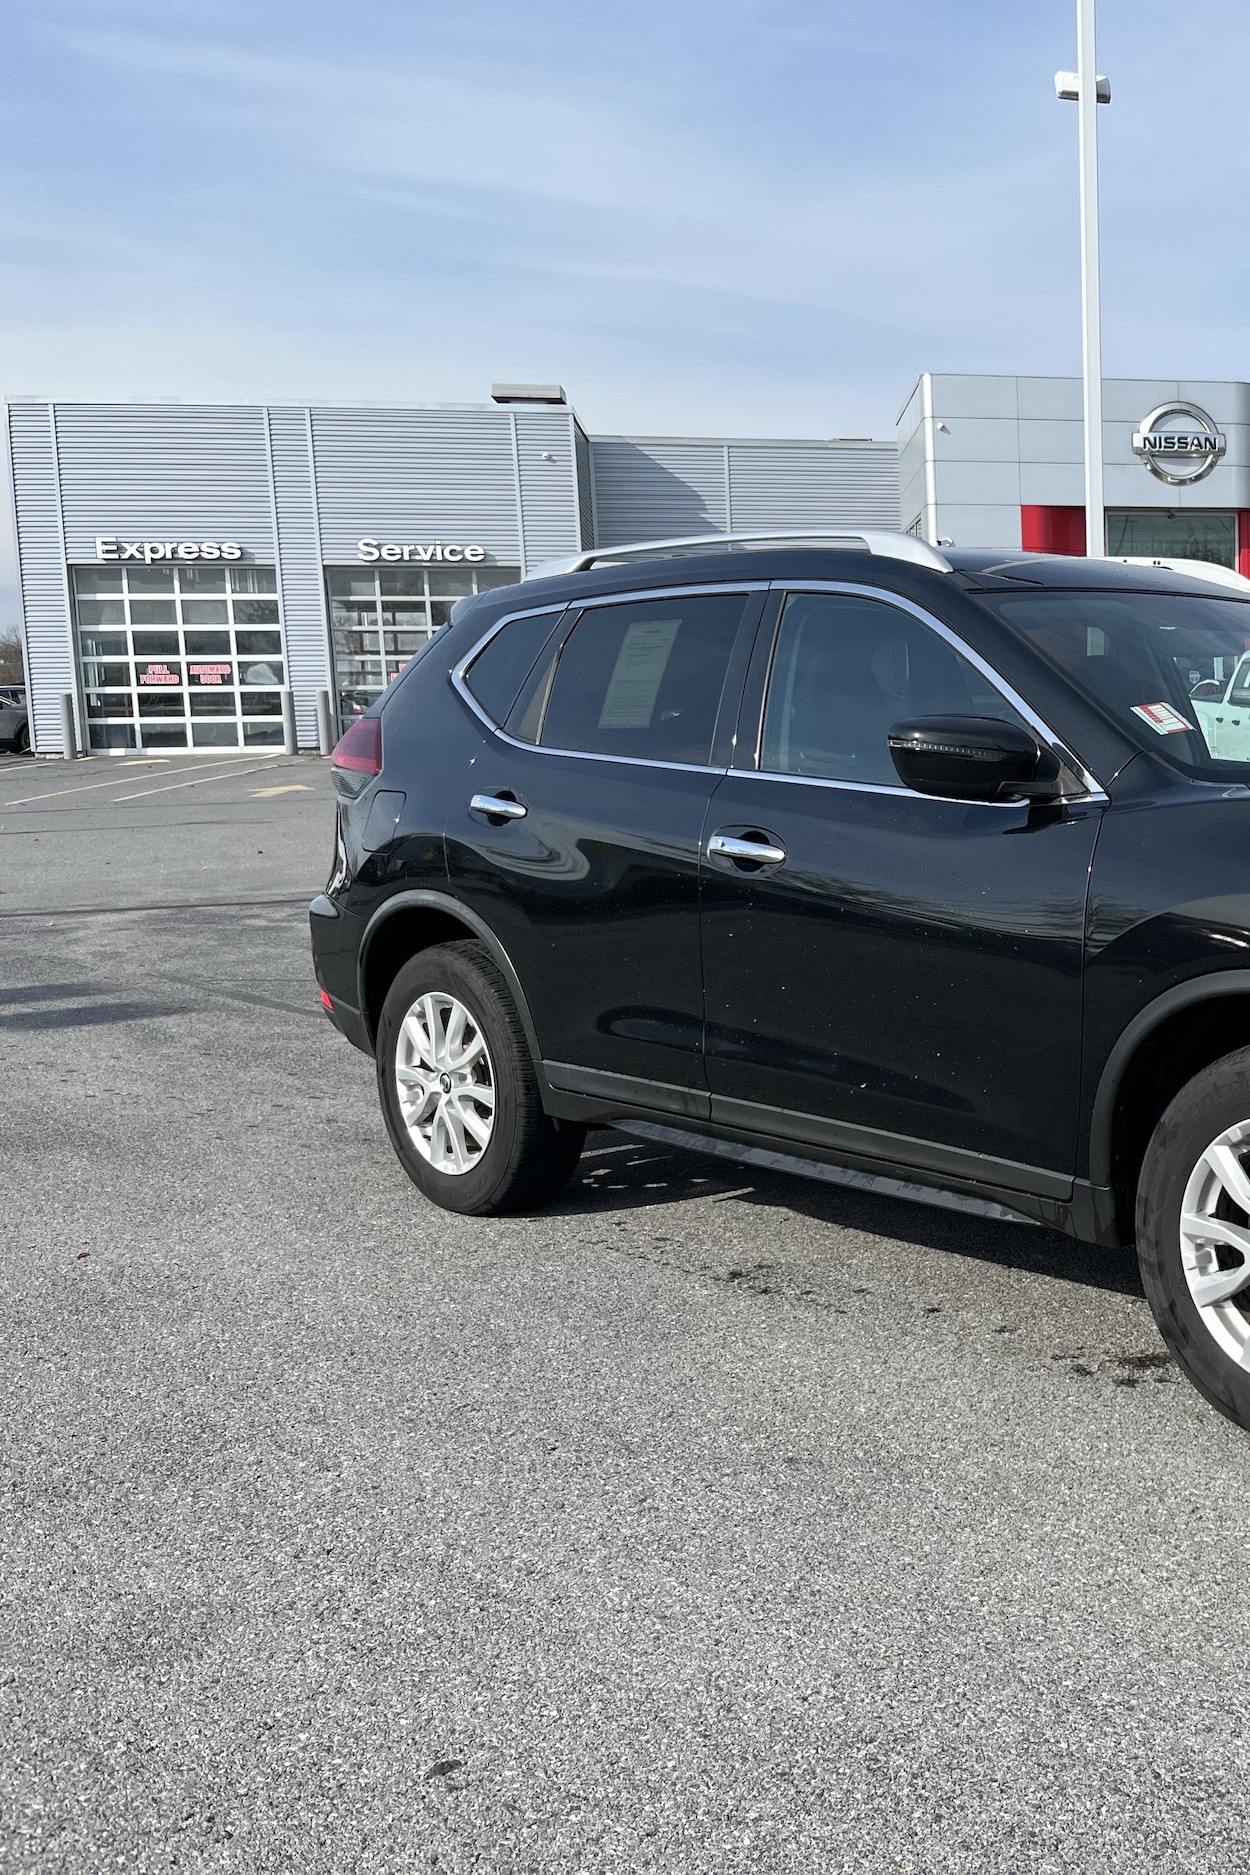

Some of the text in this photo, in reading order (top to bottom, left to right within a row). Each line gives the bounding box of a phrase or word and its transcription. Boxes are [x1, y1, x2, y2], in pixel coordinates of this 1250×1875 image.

[1142, 435, 1218, 451] NISSAN
[95, 536, 242, 564] Express
[357, 538, 485, 562] Service
[148, 664, 170, 675] PULL
[189, 664, 231, 675] AUTOMATIC
[140, 674, 180, 685] FORWARD
[200, 674, 222, 685] DOOR
